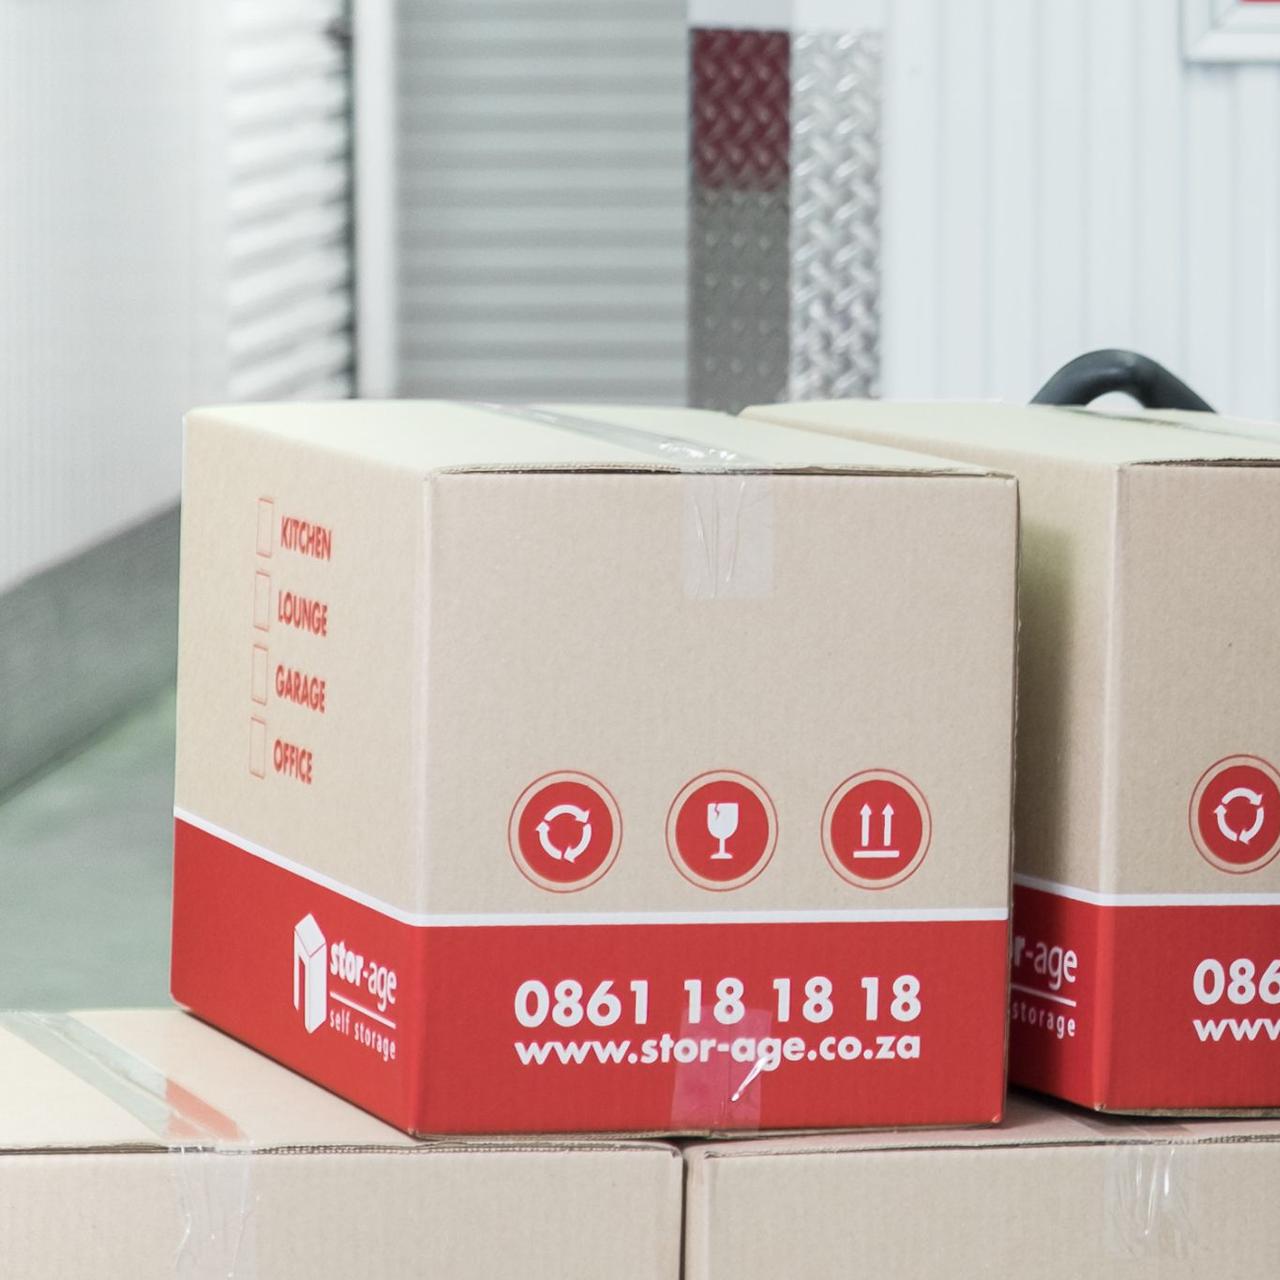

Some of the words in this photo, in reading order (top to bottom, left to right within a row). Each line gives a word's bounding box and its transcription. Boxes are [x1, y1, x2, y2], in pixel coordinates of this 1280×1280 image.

[281, 516, 332, 561] KITCHEN
[278, 589, 328, 637] LOUNGE
[275, 664, 325, 713] GARAGE
[273, 738, 313, 784] OFFICE
[330, 940, 397, 1012] stor-age
[1013, 936, 1078, 990] r-age
[514, 979, 649, 1027] 0861
[684, 977, 745, 1024] 18
[773, 976, 834, 1023] 18
[861, 975, 922, 1022] 18
[1012, 1001, 1076, 1039] storage
[330, 1009, 350, 1035] self
[354, 1022, 396, 1062] storage
[514, 1033, 921, 1071] www.stor-age.co.za
